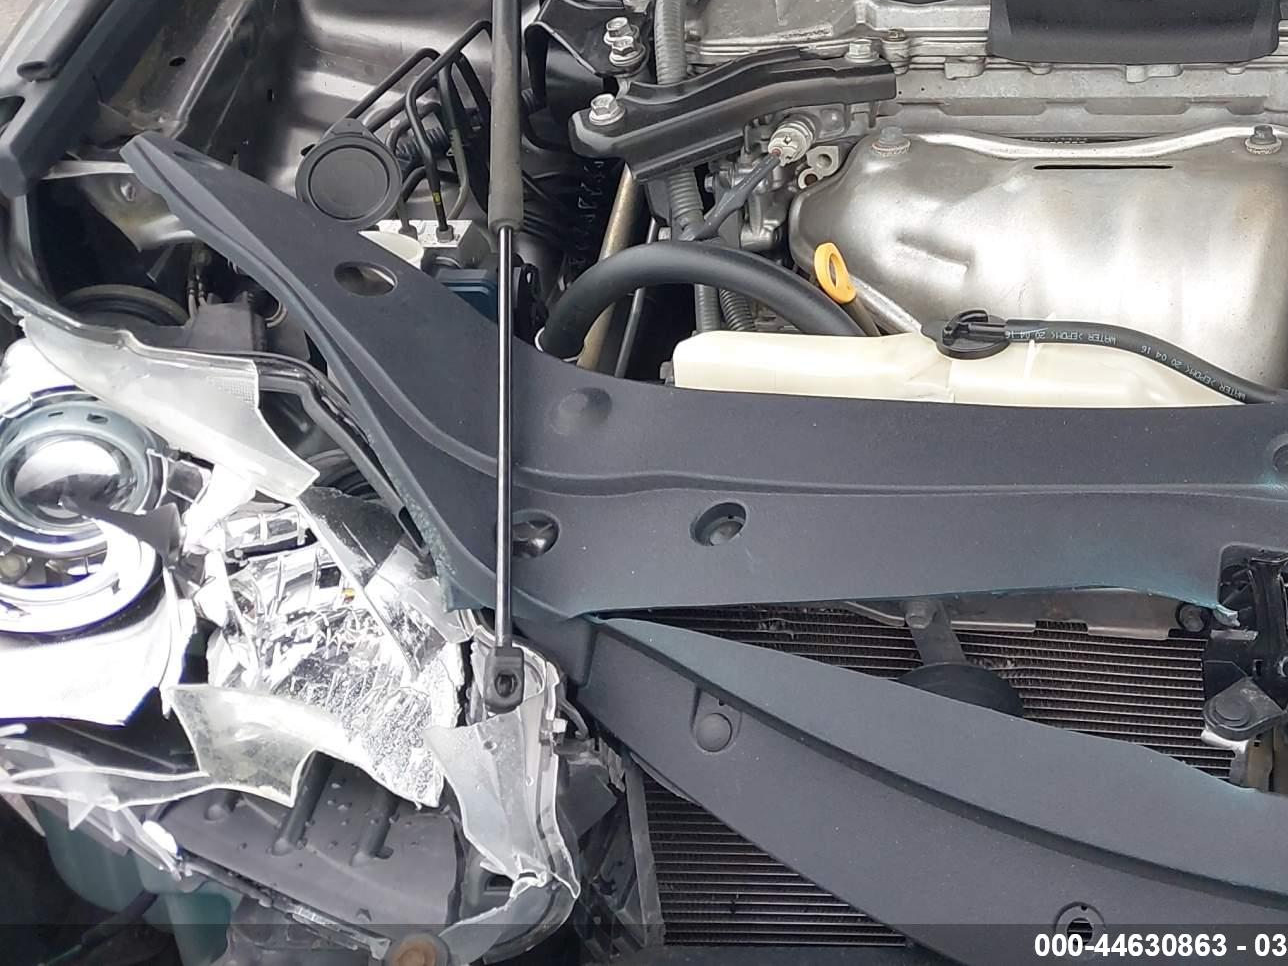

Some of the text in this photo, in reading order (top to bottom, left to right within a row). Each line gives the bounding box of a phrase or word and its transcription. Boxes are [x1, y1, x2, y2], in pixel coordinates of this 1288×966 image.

[1087, 333, 1117, 345] WATER
[1170, 358, 1183, 369] 20
[1219, 382, 1246, 401] WATER
